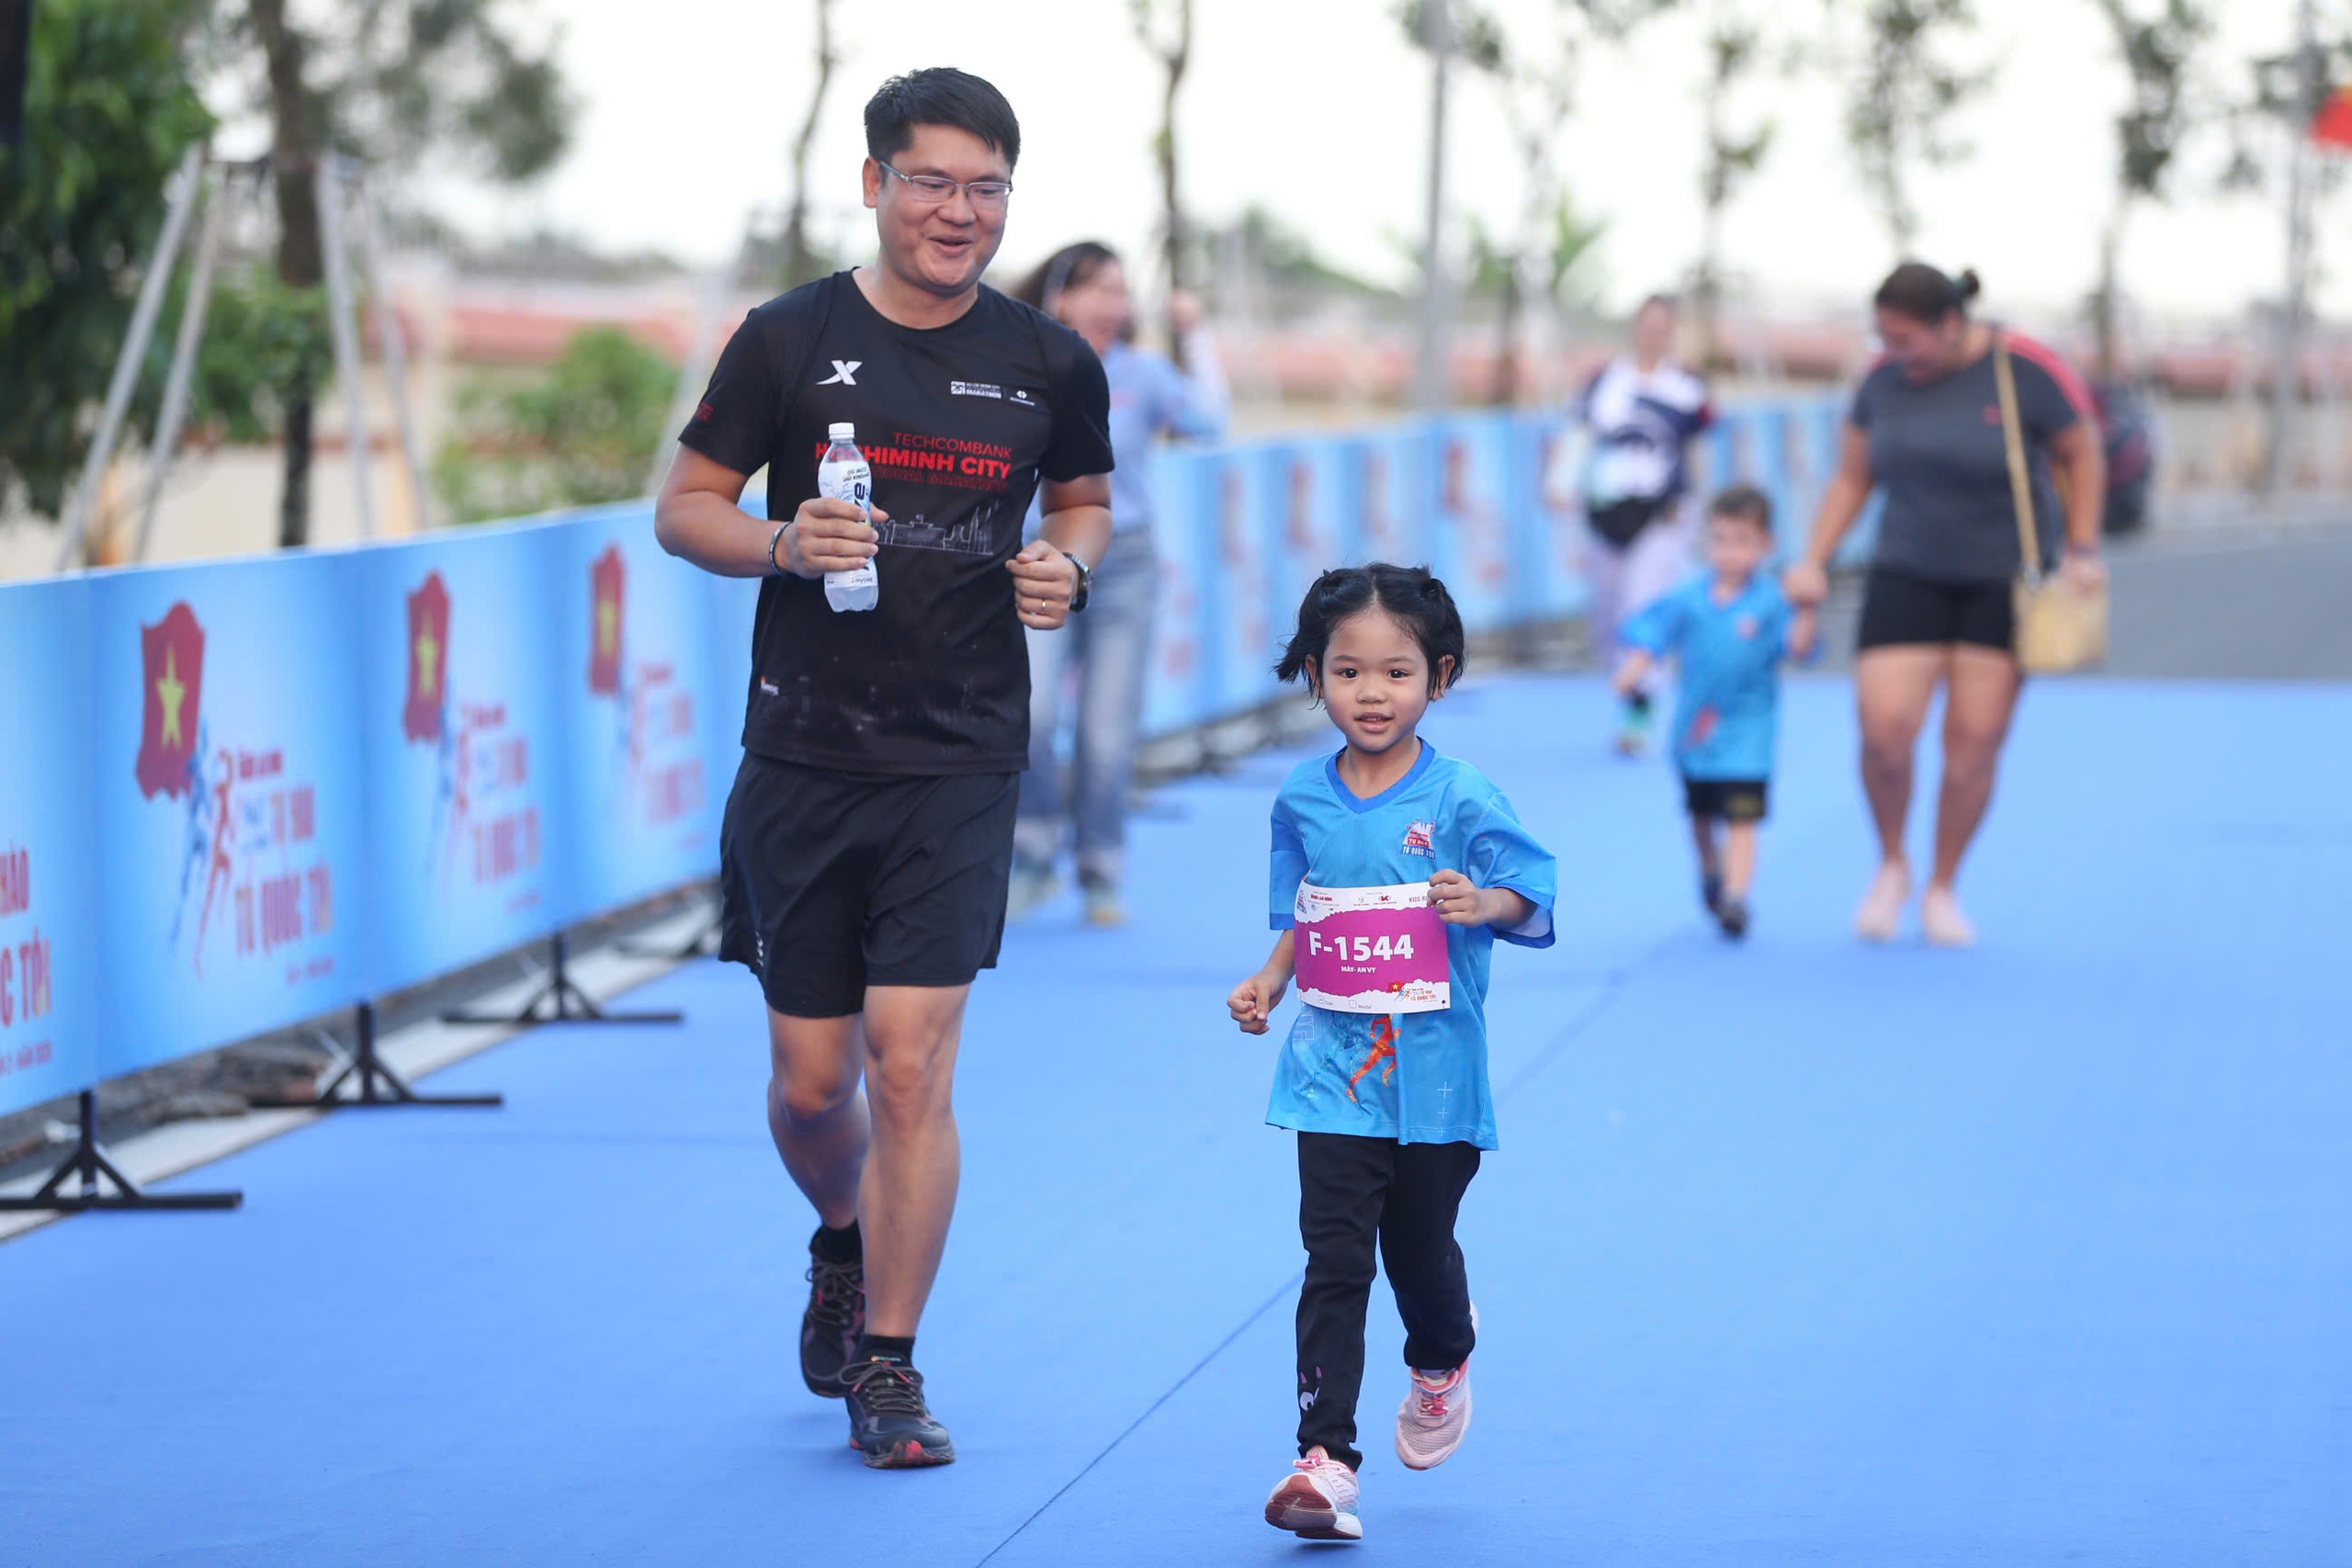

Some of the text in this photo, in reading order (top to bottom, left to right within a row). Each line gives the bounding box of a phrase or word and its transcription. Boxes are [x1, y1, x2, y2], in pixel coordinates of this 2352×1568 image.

[893, 431, 1012, 459] TECHCOMBANK
[959, 457, 1012, 480] CITY
[1308, 931, 1415, 962] F-1544
